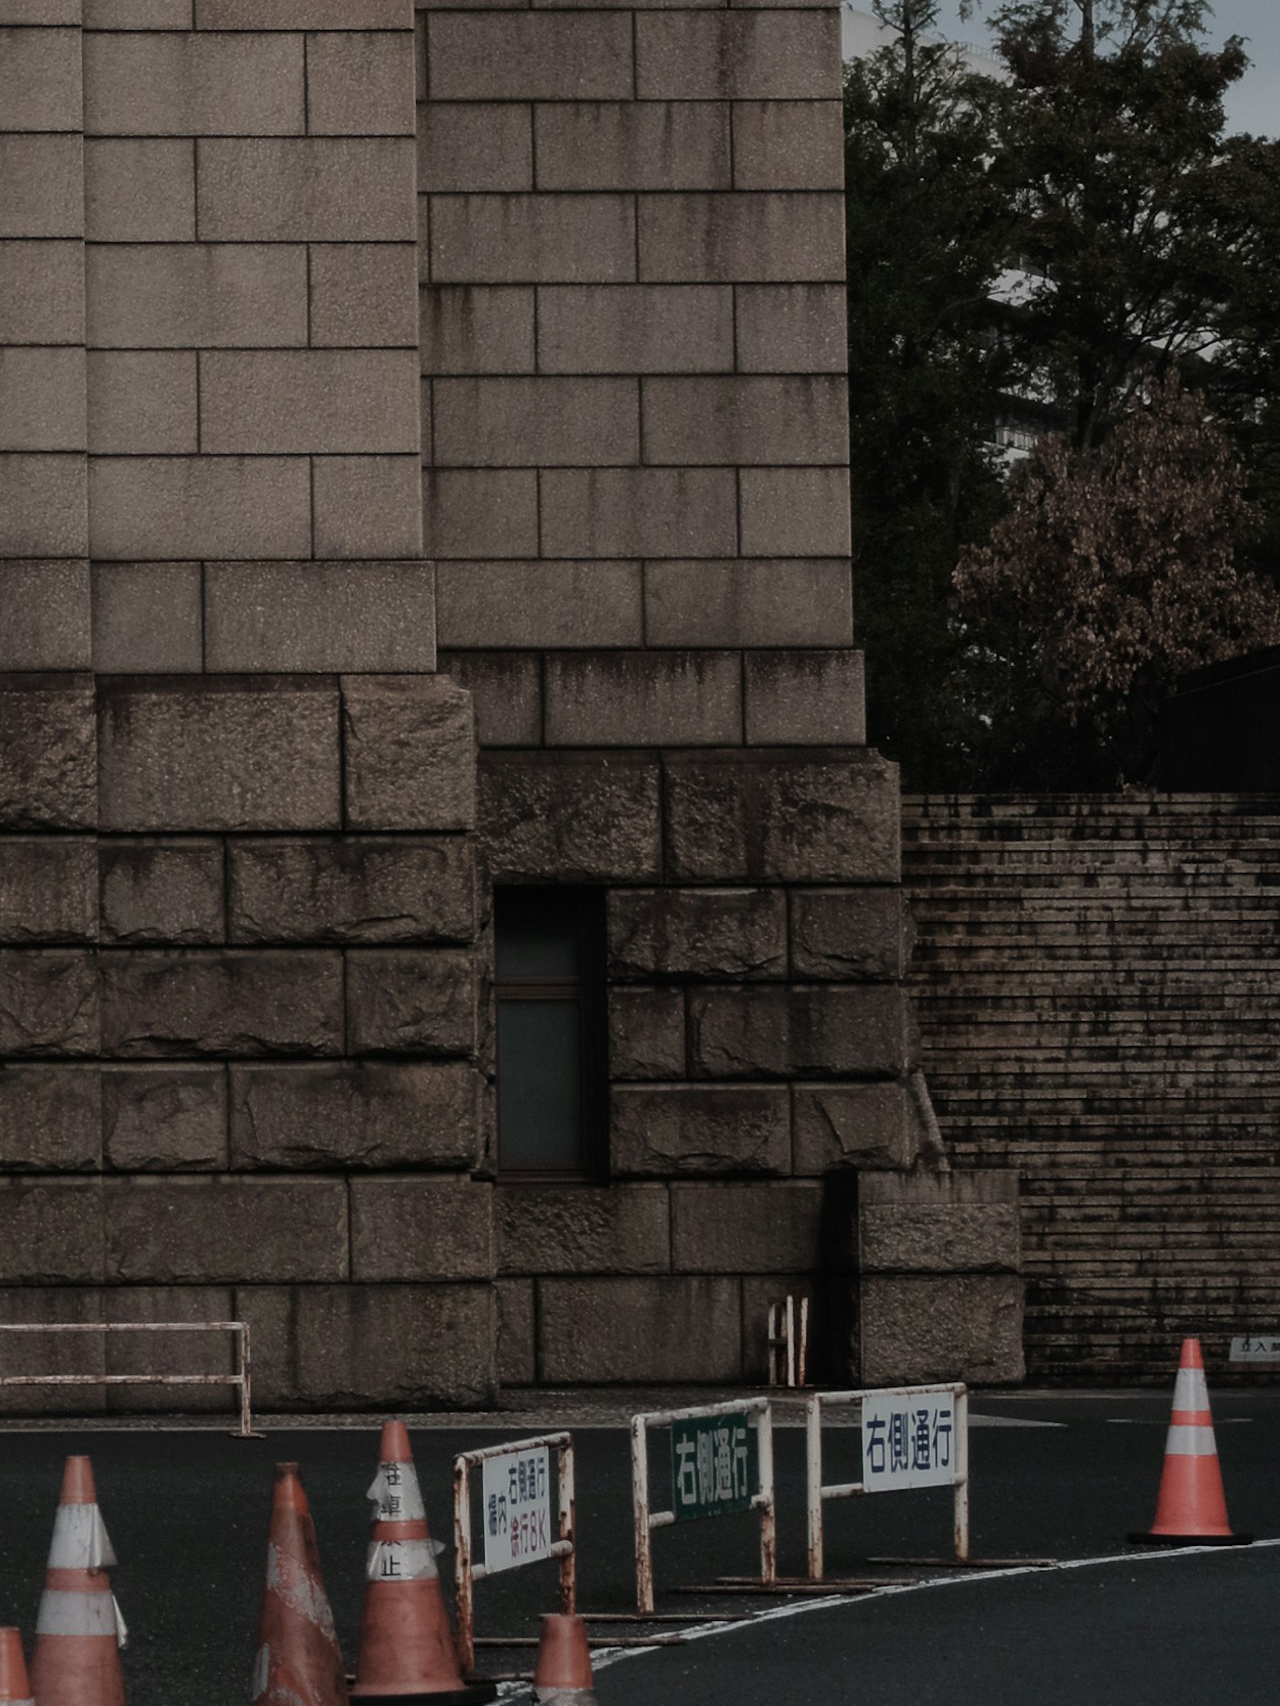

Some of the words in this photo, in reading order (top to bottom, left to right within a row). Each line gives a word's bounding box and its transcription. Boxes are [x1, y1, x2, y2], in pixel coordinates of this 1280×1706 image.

[675, 1426, 748, 1506] 右側通行
[866, 1408, 953, 1473] 右側通行
[508, 1456, 545, 1505] 右側通行
[510, 1508, 547, 1558] 徐行8K
